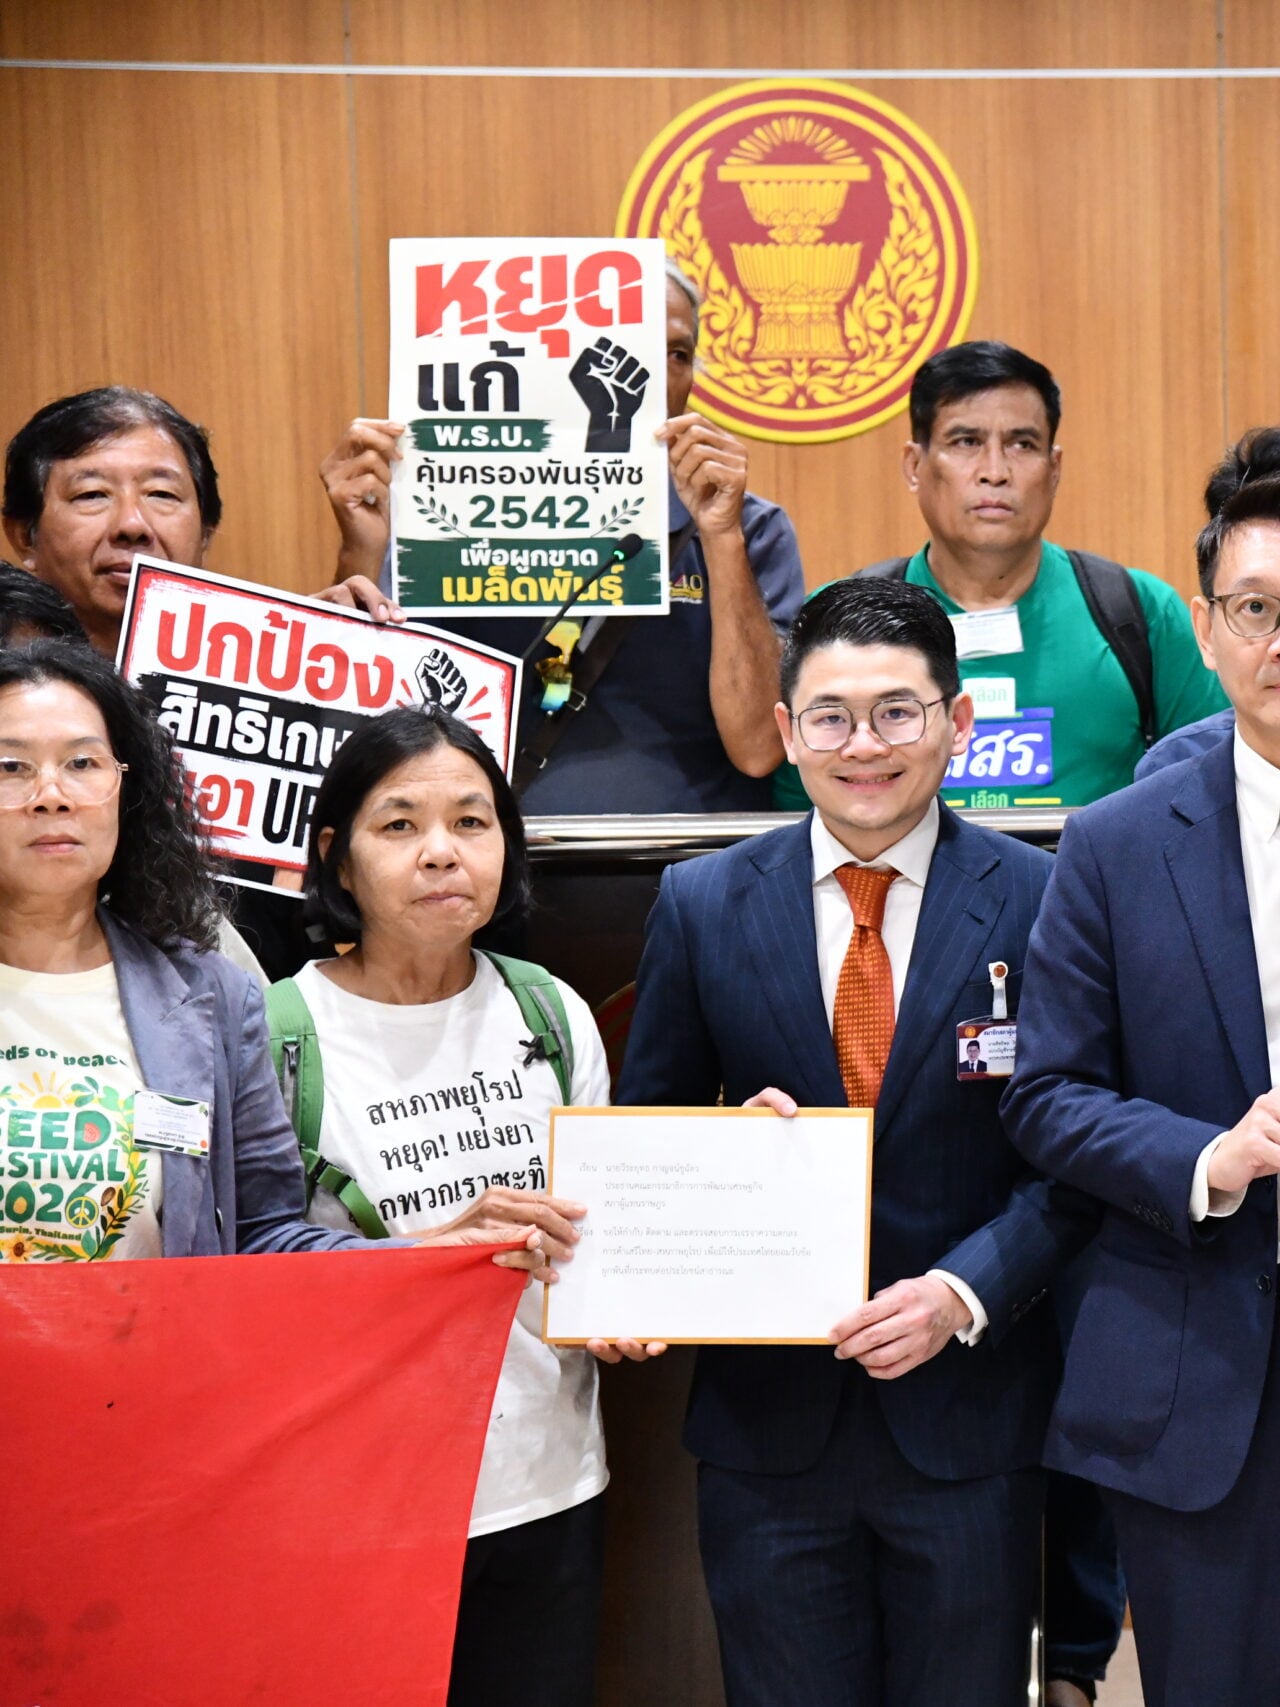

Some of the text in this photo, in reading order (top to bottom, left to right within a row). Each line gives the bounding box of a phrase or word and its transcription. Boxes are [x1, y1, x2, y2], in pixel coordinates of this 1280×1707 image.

[415, 250, 643, 359] หยุด
[417, 340, 525, 412] แก้
[434, 424, 532, 447] พ.ร.บ.
[416, 457, 644, 494] คุ้มครองพันธุ์พืช
[468, 495, 590, 529] 2542
[460, 538, 599, 574] เพื่อผูกขาด
[442, 564, 625, 606] เมล็ดพันธุ์
[156, 602, 395, 708] ปกป้อง
[366, 1069, 523, 1125] สหภาพยุโรป
[0, 1109, 112, 1151] EED
[380, 1116, 534, 1173] หยุด! แย่งยา
[0, 1148, 126, 1182] STIVAL
[0, 1180, 99, 1229] 026
